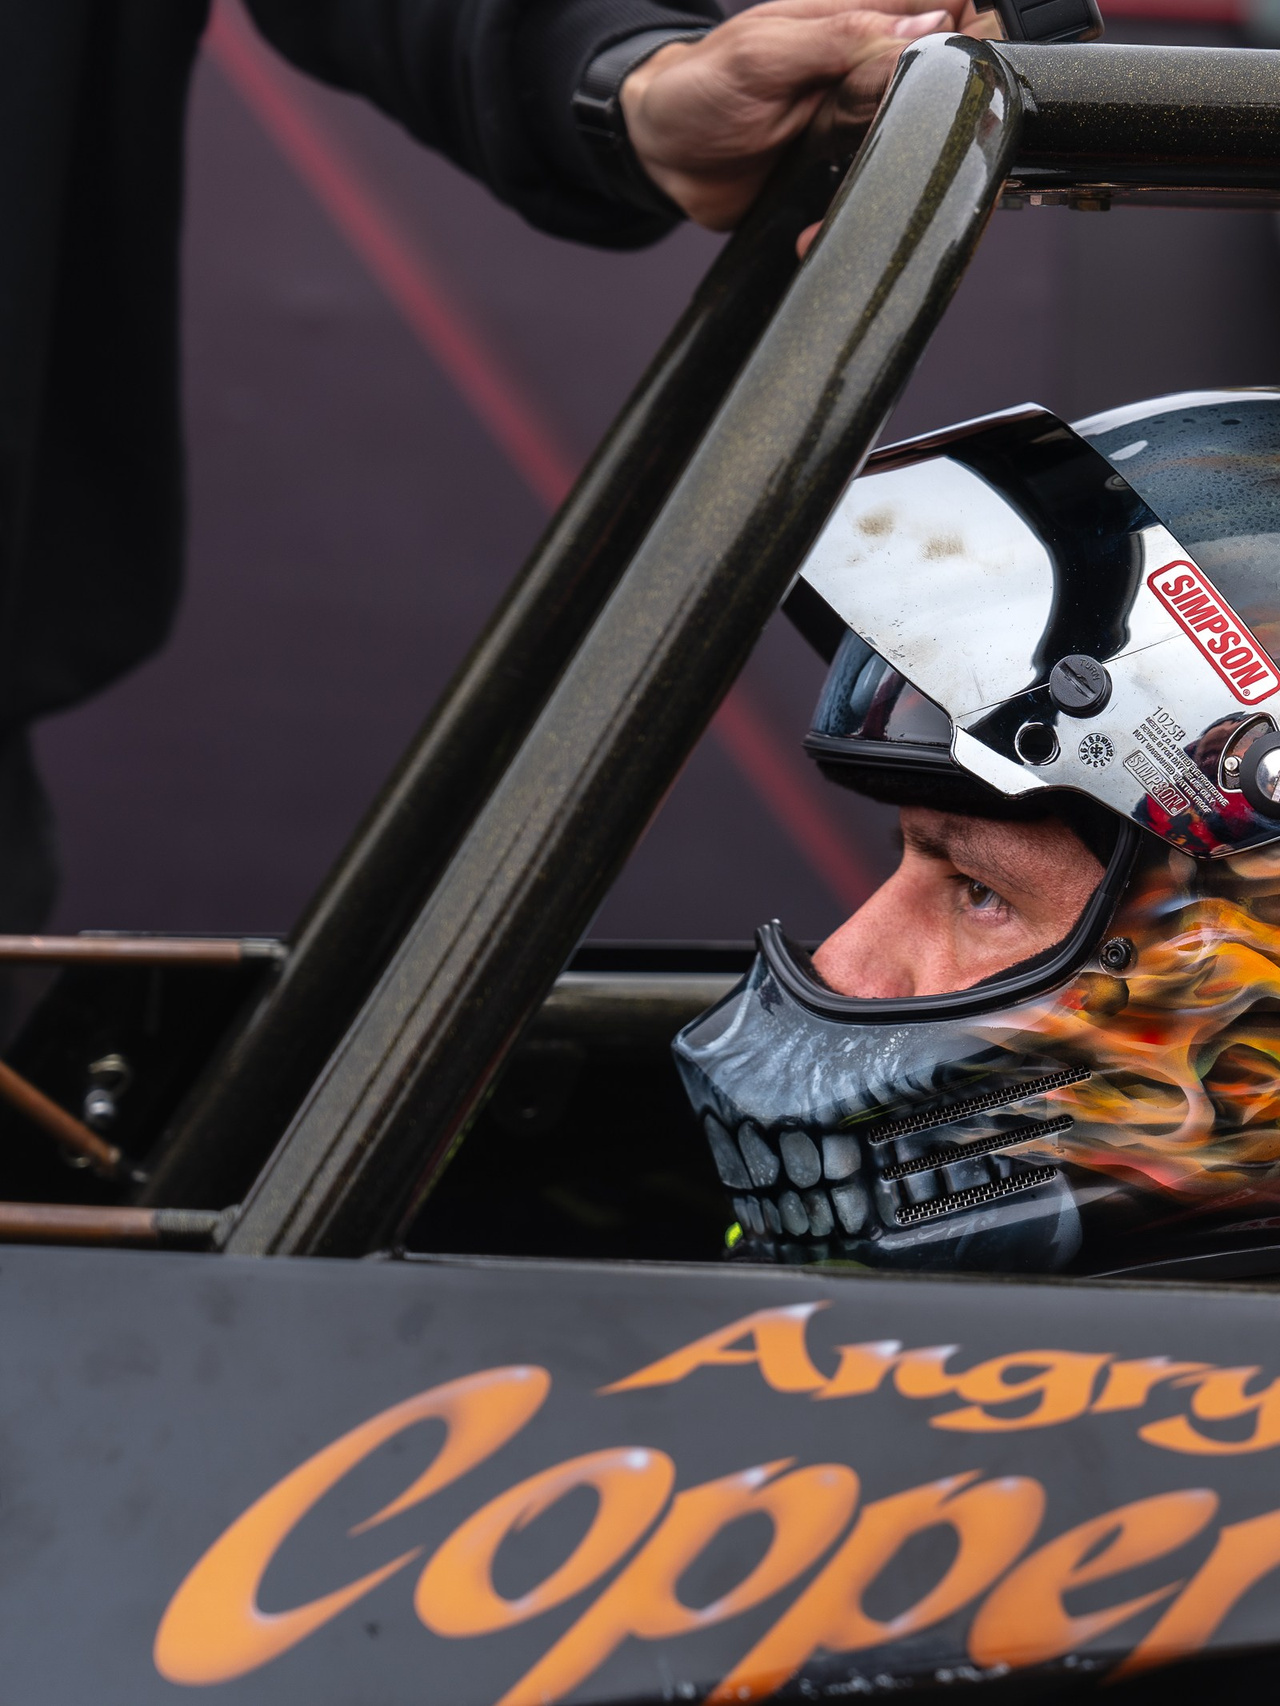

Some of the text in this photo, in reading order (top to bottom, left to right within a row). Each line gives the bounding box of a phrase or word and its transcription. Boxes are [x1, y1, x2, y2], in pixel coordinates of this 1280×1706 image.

[1161, 574, 1269, 690] SIMPSON
[1079, 657, 1101, 682] TURN
[1132, 728, 1148, 745] NOT
[1160, 745, 1173, 759] FOR
[1127, 754, 1186, 812] SIMPSON
